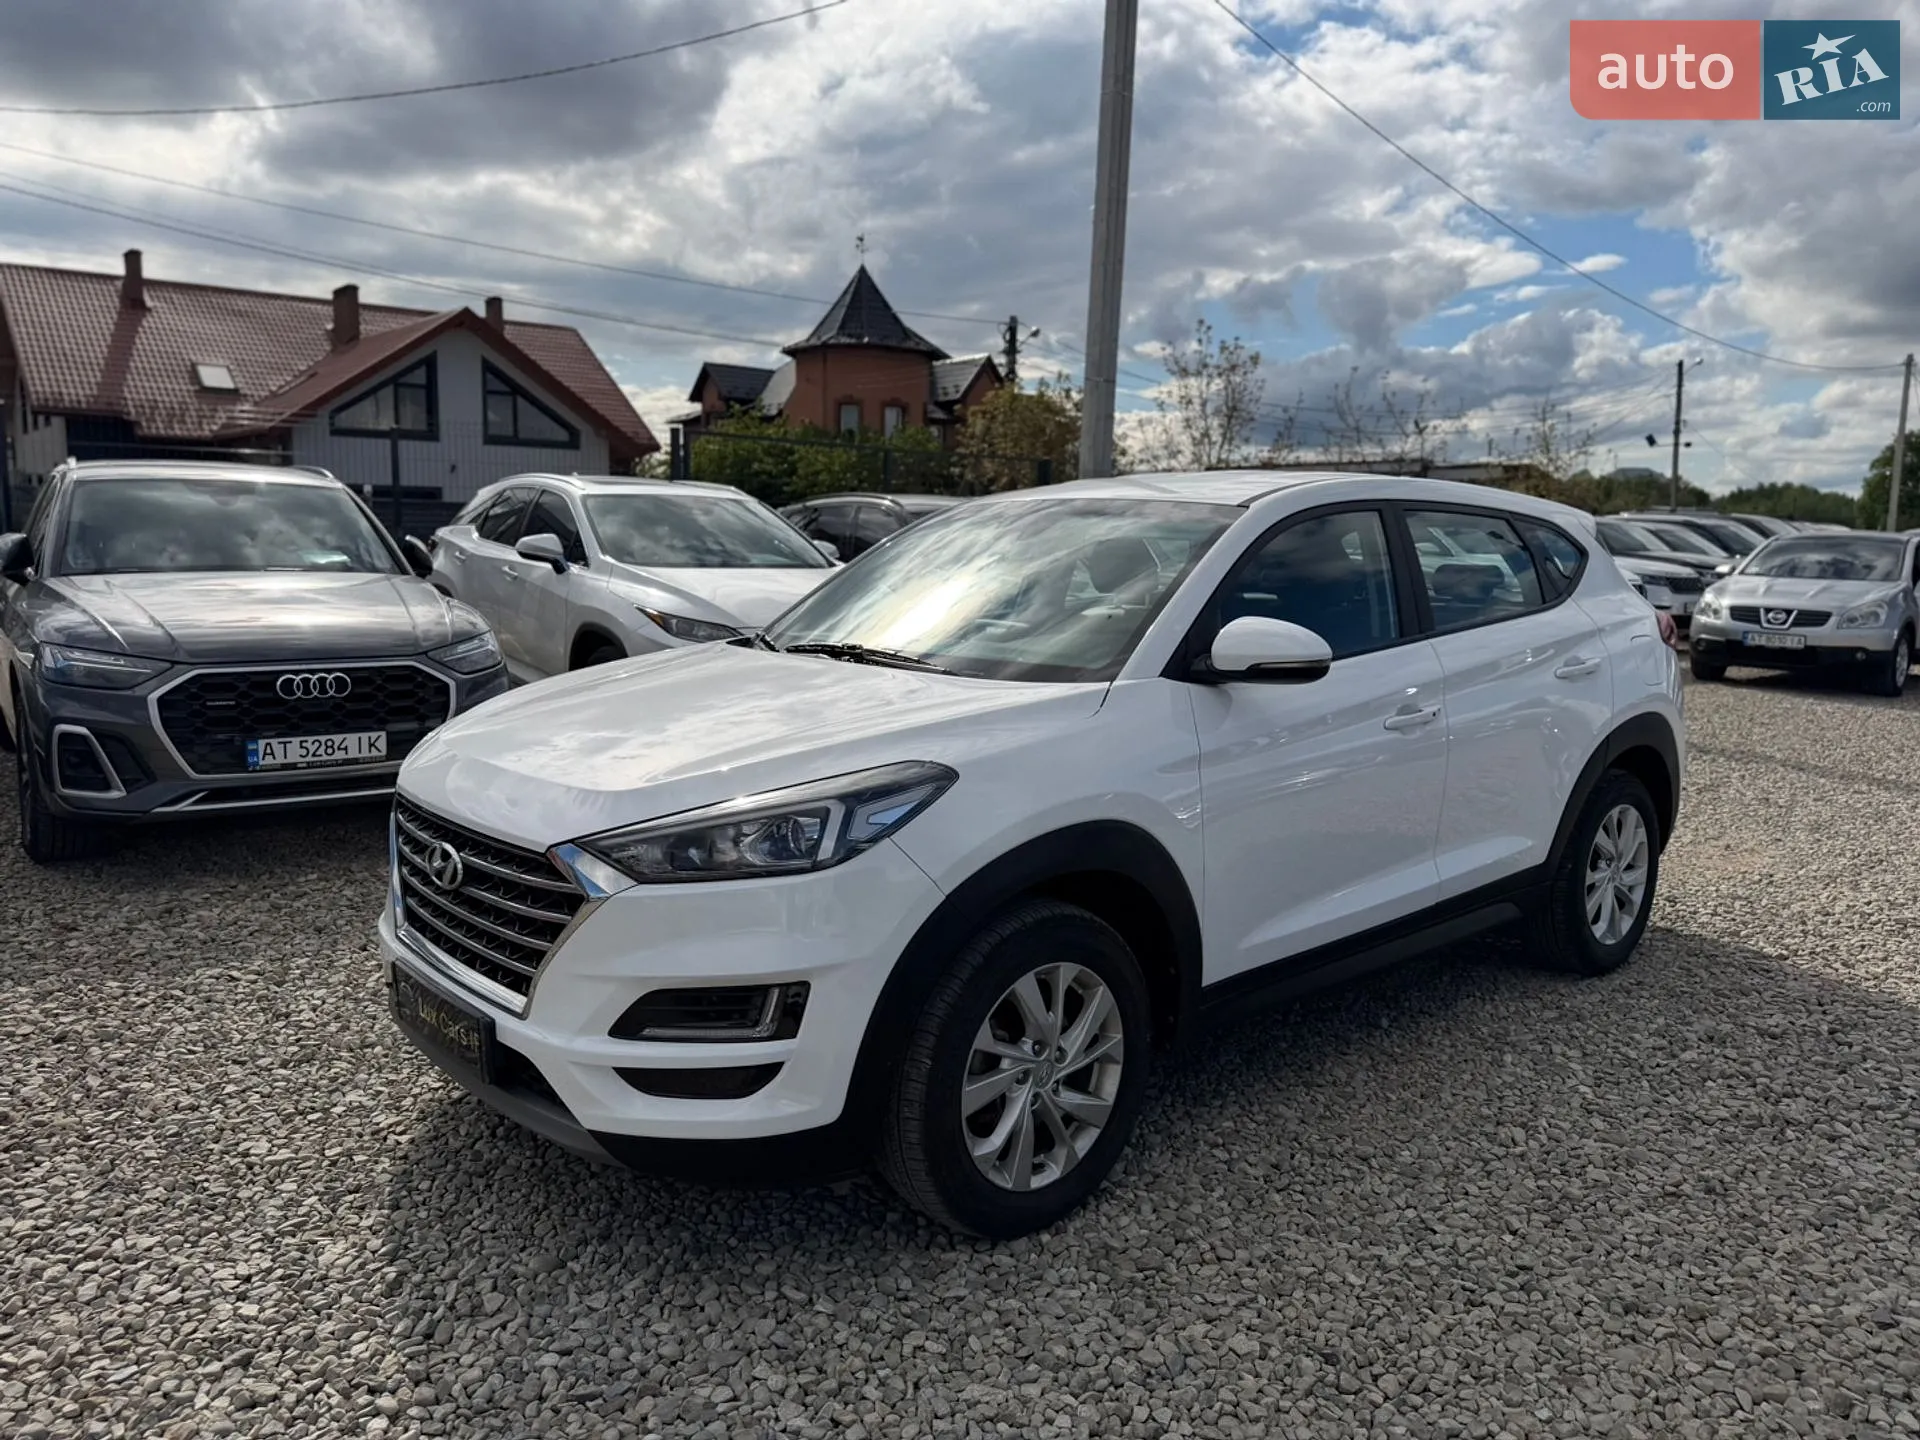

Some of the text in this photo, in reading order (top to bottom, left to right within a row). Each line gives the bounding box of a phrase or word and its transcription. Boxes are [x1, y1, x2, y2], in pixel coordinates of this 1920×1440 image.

[262, 735, 382, 761] AT 5284 IK
